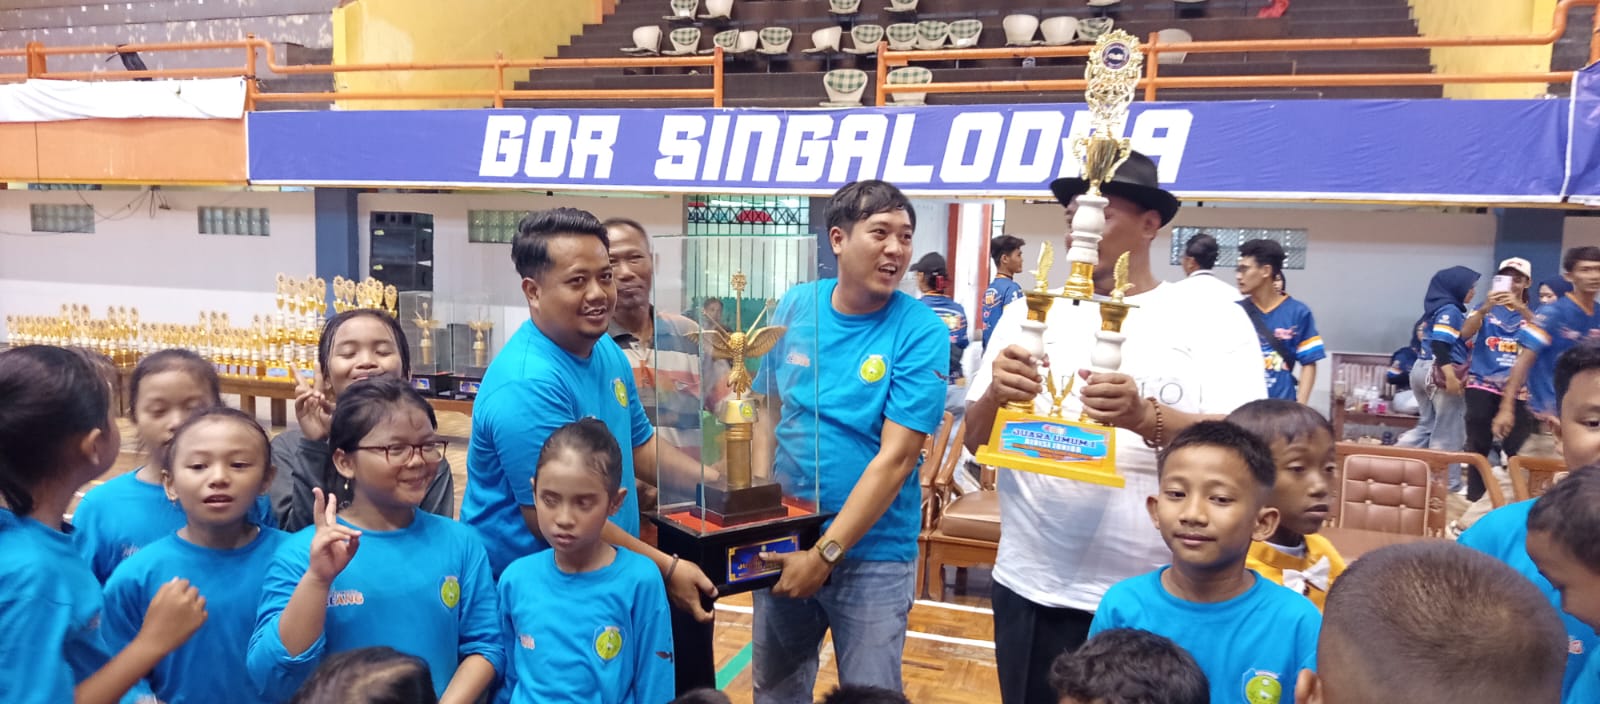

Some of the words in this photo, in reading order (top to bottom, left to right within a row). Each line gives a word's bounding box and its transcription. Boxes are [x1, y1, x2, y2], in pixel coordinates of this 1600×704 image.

[479, 114, 621, 179] GOR
[1012, 428, 1051, 441] JUARA
[1053, 434, 1089, 448] UMUM
